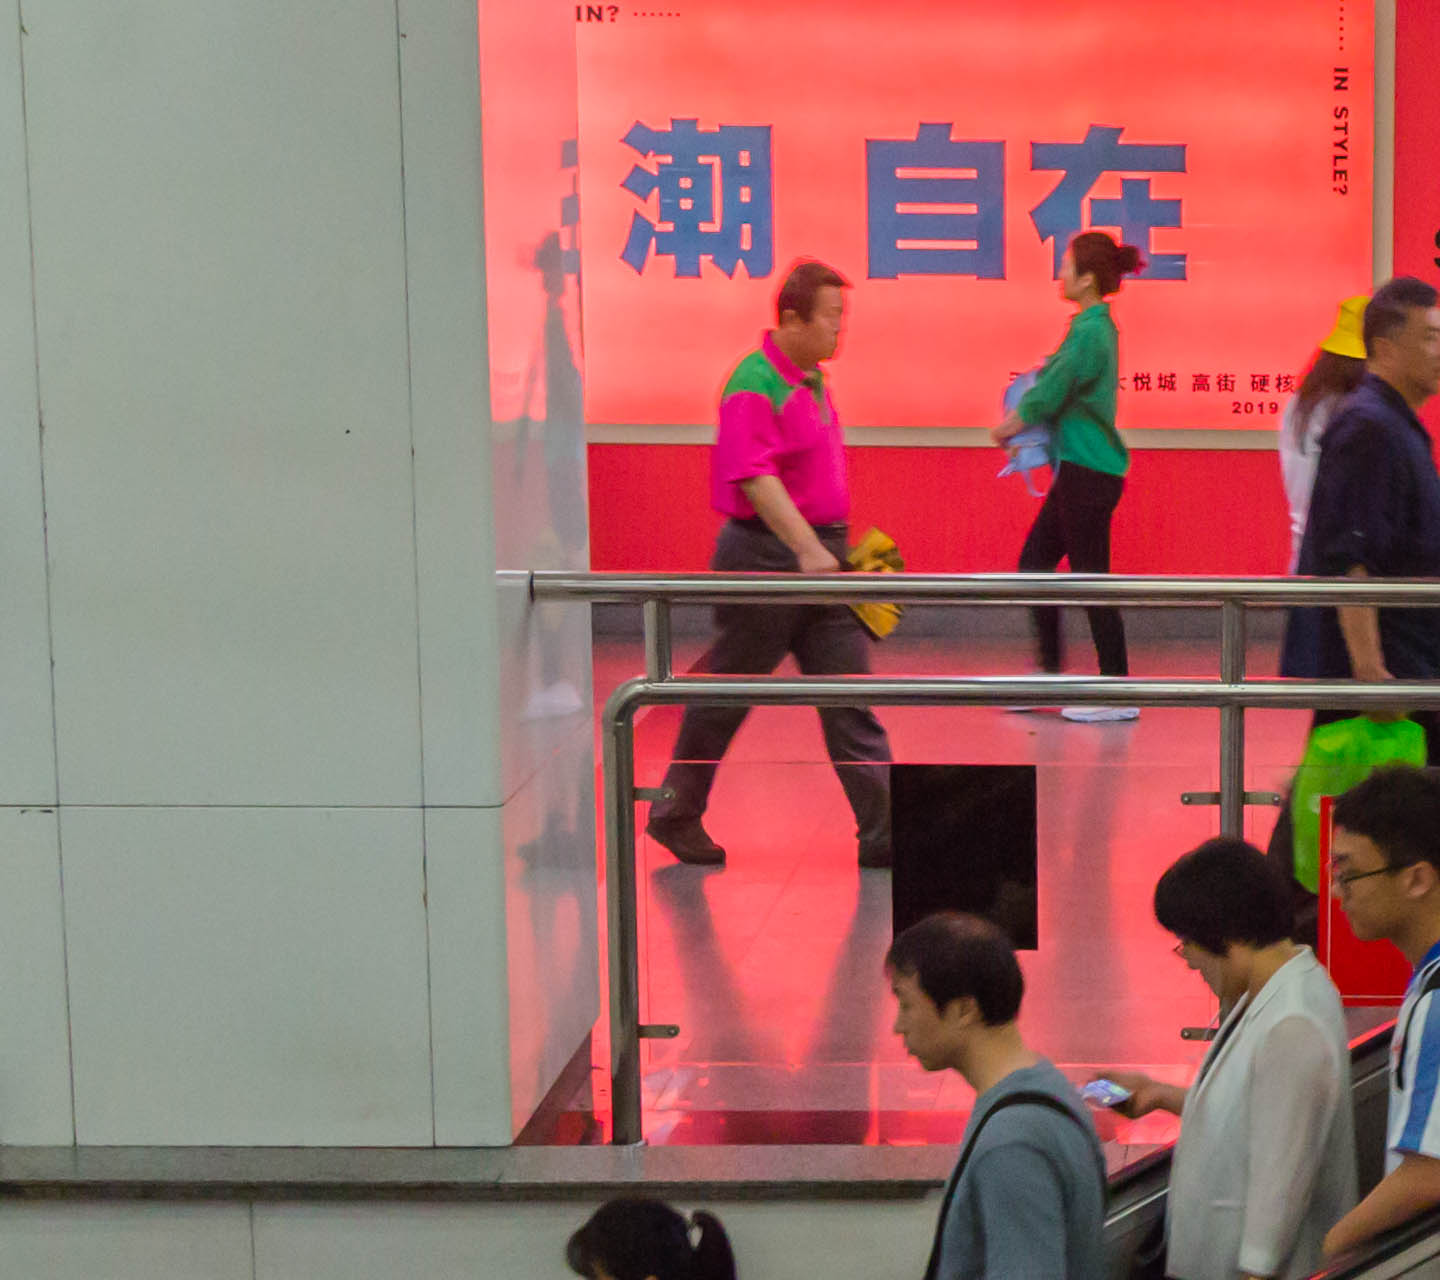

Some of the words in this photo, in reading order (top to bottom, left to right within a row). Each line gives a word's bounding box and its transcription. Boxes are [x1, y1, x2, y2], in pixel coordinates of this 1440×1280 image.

[575, 5, 620, 23] IN?
[1334, 67, 1350, 91] IN
[1333, 106, 1350, 197] STYLE?
[620, 118, 775, 280] 潮
[865, 122, 1188, 282] 自在
[1192, 373, 1236, 393] 高街
[1232, 401, 1279, 414] 2019
